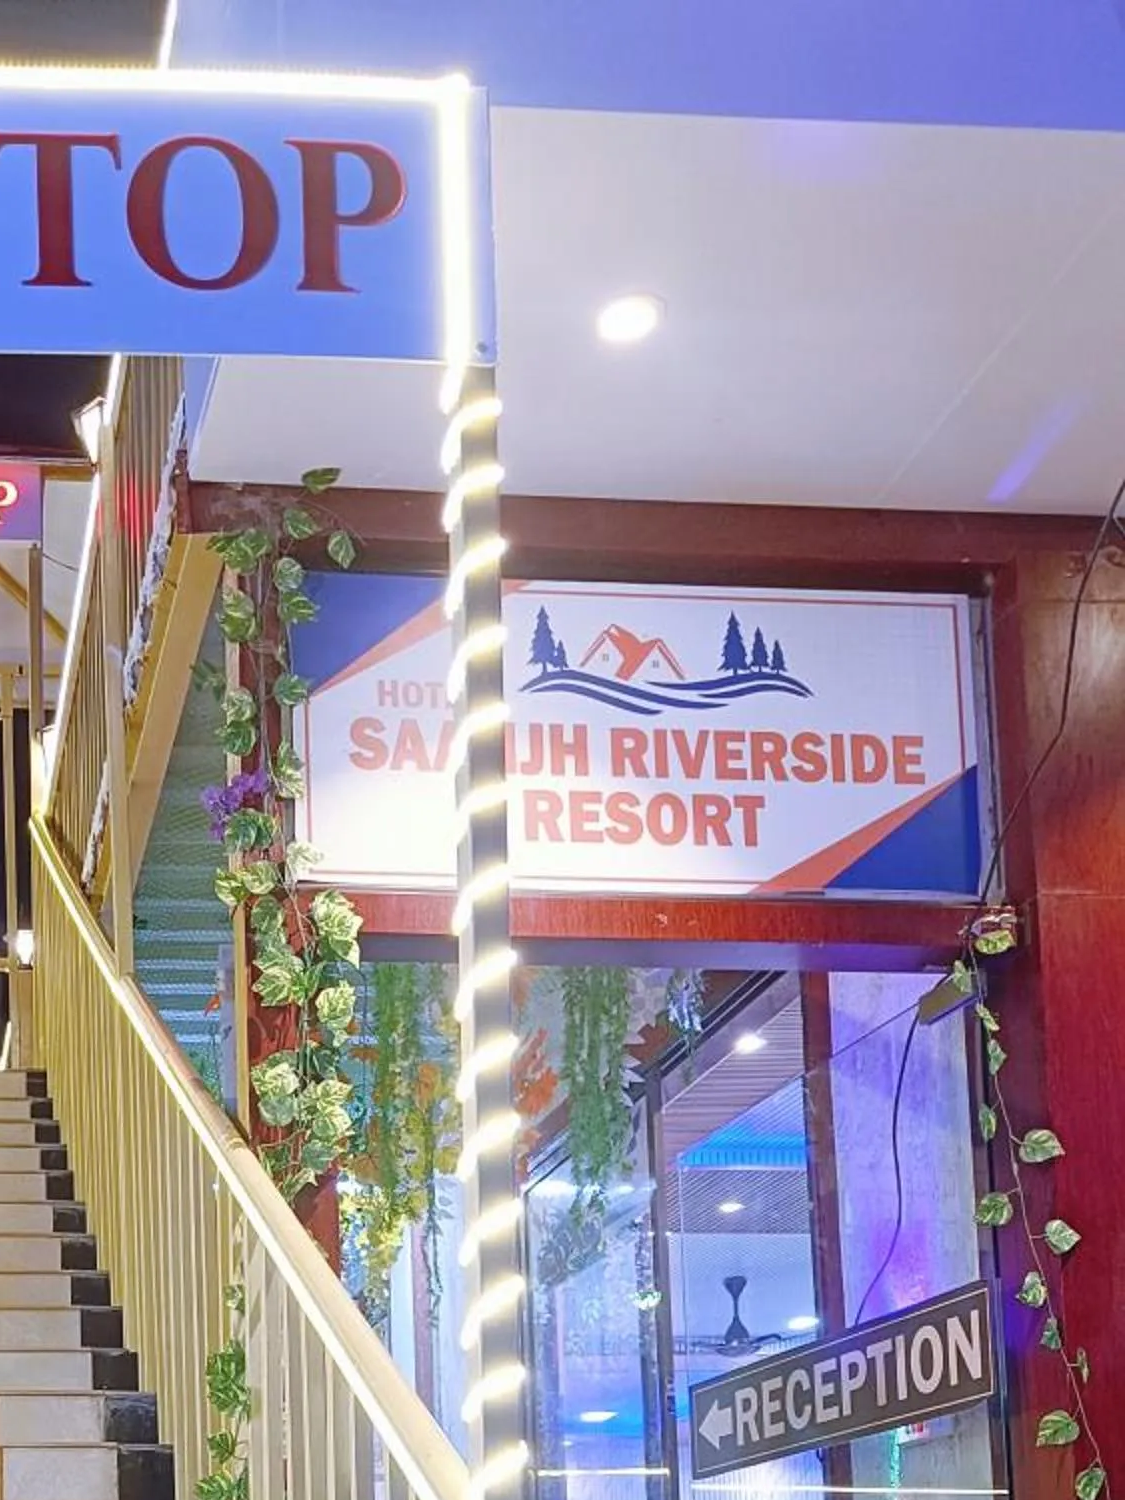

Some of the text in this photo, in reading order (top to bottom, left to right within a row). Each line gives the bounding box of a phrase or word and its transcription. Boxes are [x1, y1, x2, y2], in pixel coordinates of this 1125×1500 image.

[377, 679, 456, 709] HOT
[610, 726, 926, 786] RIVERSIDE
[523, 790, 765, 848] RESORT
[734, 1309, 983, 1447] RECEPTION
